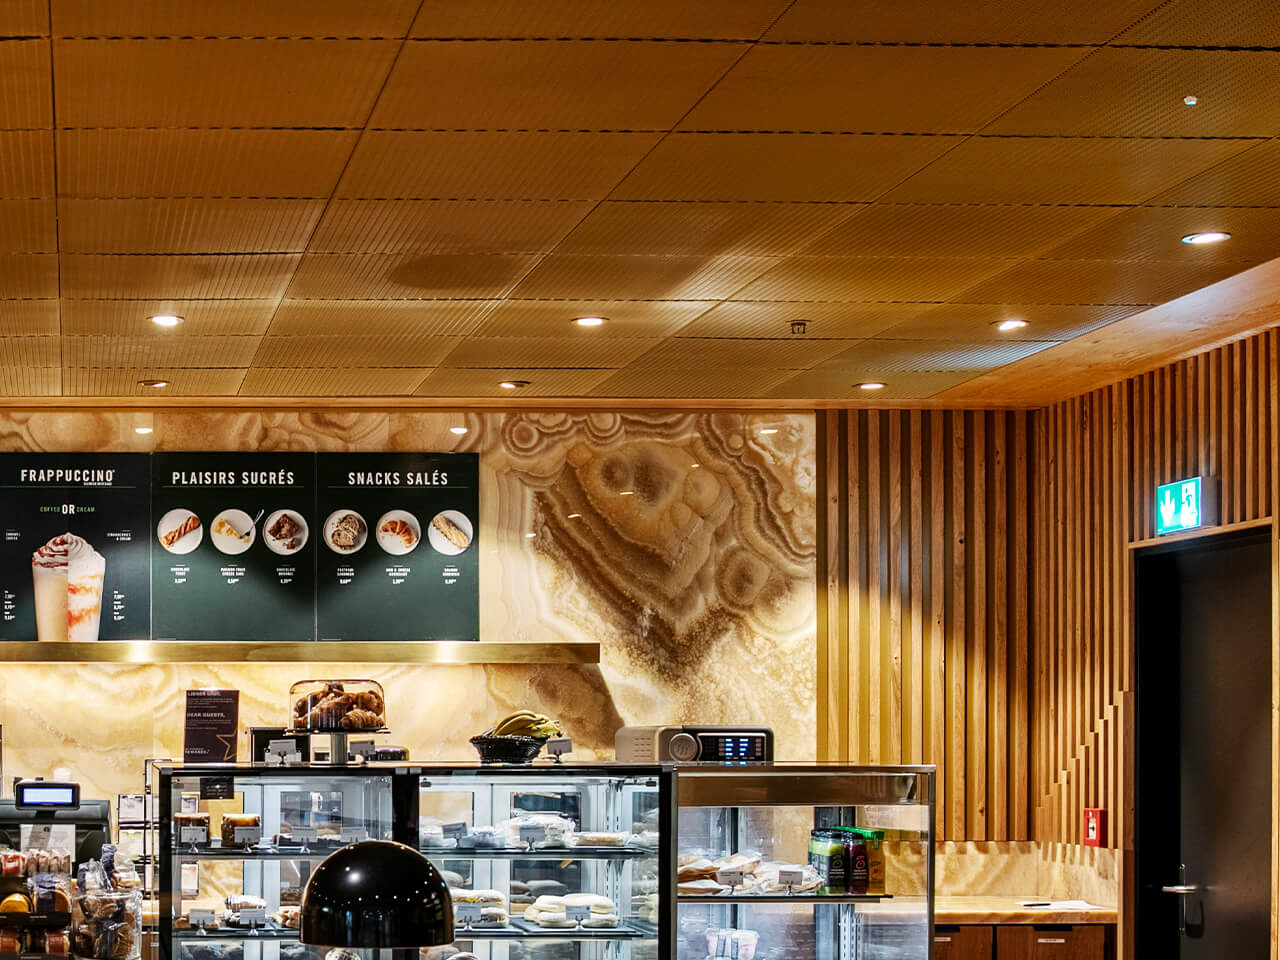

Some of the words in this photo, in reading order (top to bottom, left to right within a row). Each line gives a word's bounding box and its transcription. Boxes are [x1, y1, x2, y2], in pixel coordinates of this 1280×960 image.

[172, 472, 235, 484] PLAISIRS
[242, 469, 295, 484] SUCRÉS
[348, 472, 400, 485] SNACKS
[407, 470, 448, 485] SALÉS
[62, 504, 75, 514] OR
